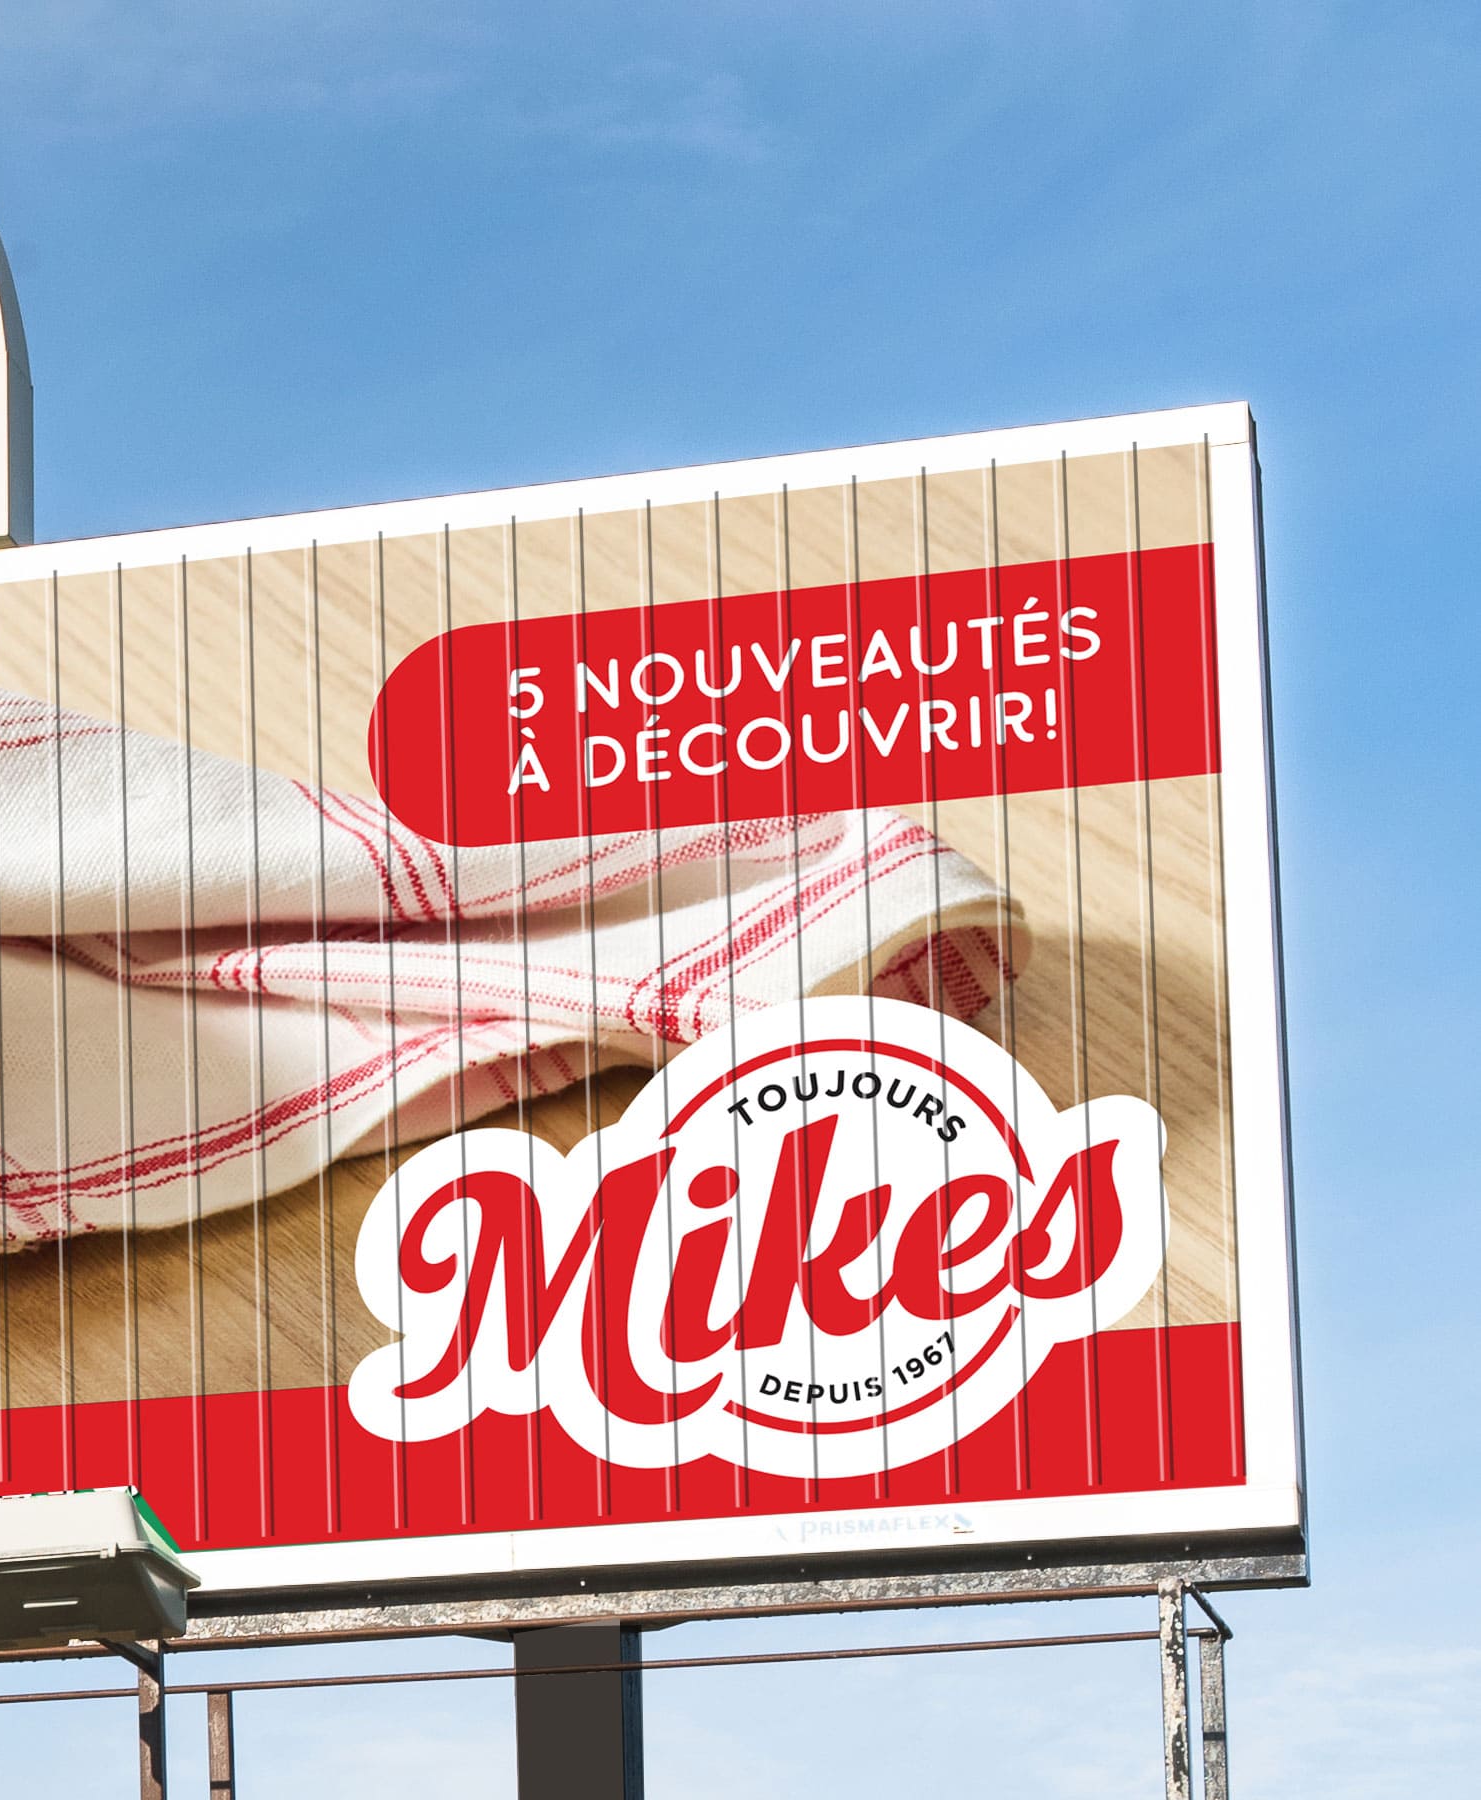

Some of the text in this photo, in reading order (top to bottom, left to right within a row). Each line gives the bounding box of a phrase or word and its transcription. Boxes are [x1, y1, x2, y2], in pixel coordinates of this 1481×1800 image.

[509, 599, 1103, 719] 5 NOUVEAUTÉS
[507, 688, 1059, 796] À DÉCOUVRIR!
[727, 1070, 967, 1142] TOUJOURS
[391, 1113, 1123, 1427] Mikes
[759, 1331, 955, 1404] DEPUIS 1967
